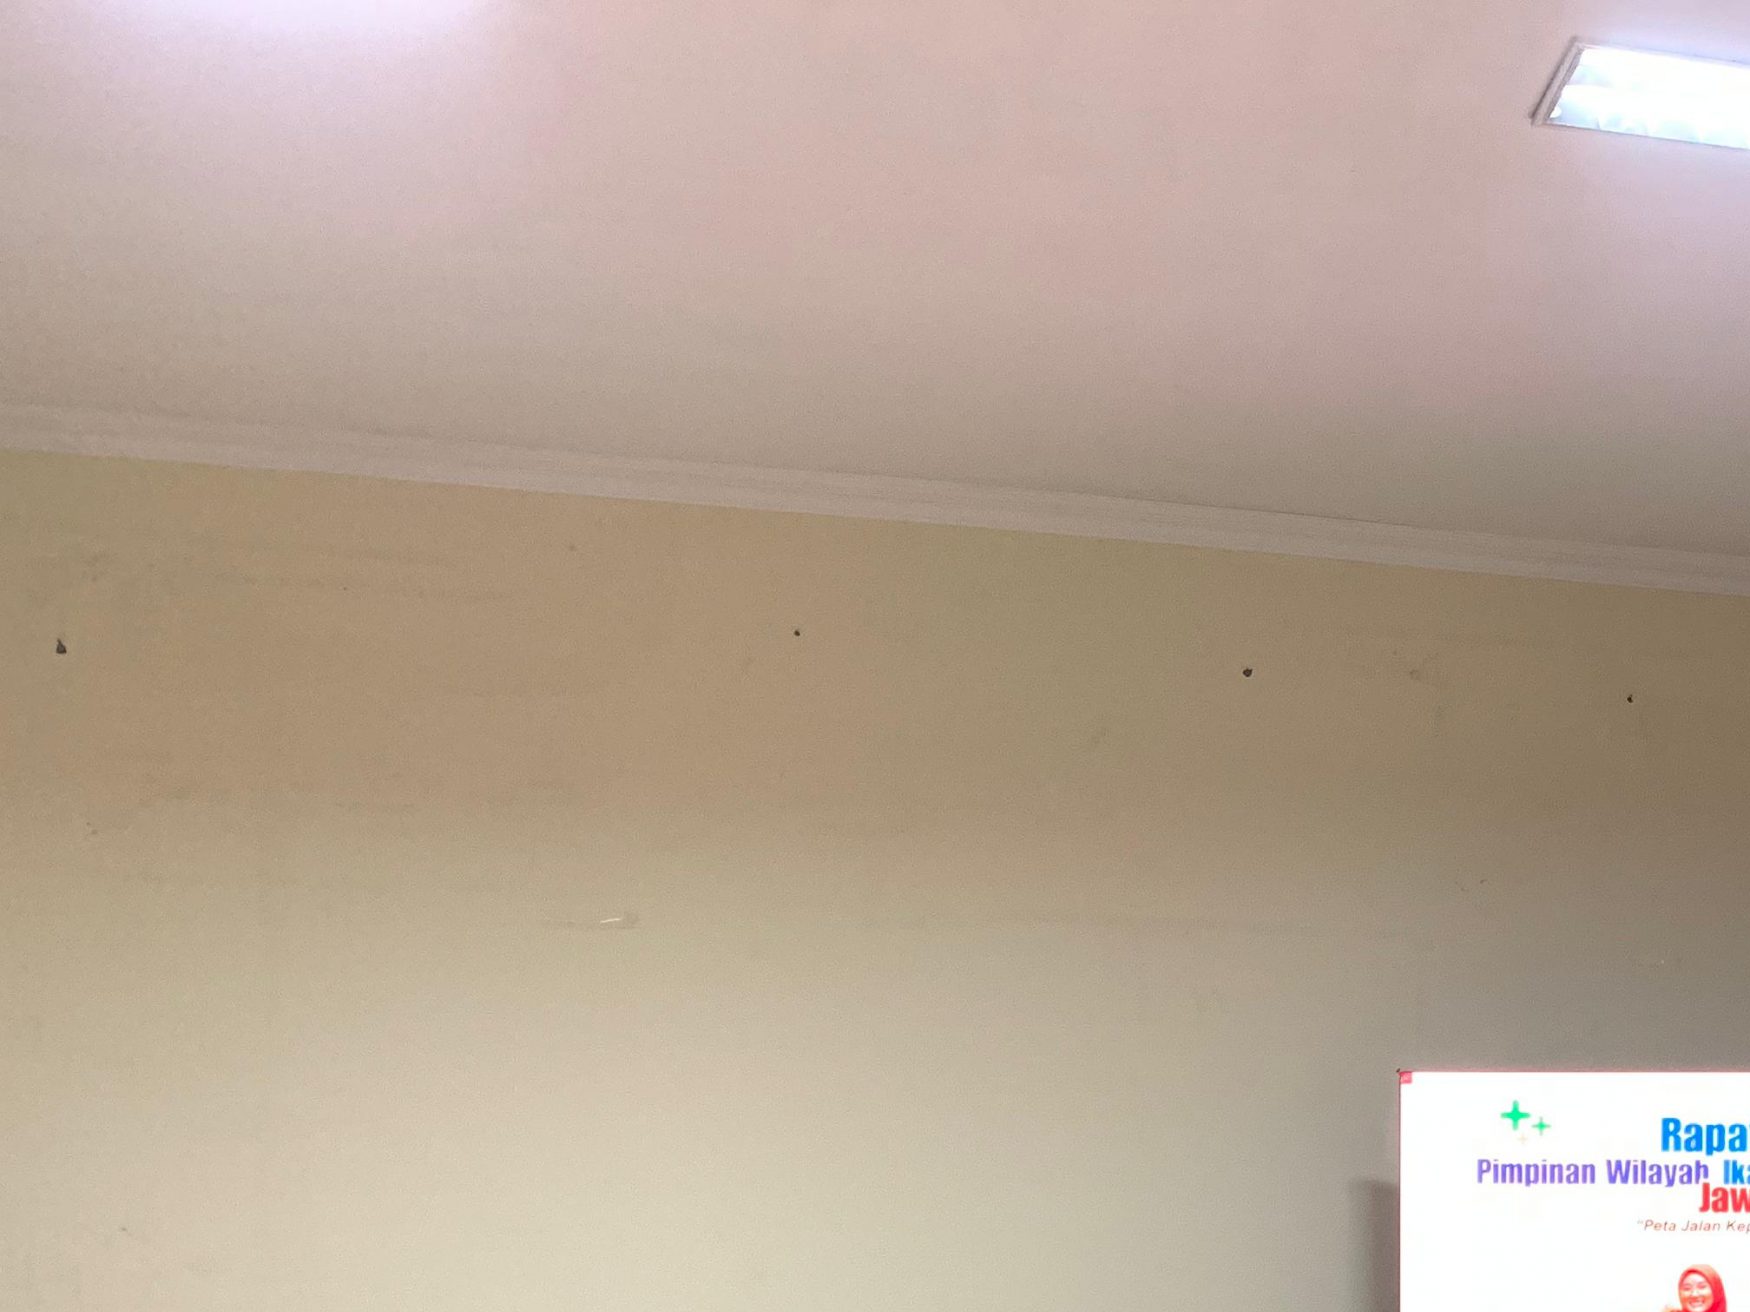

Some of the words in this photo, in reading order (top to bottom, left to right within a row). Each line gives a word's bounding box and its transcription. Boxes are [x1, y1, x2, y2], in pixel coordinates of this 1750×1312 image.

[1477, 1158, 1596, 1187] Pimpinan
[1606, 1159, 1709, 1188] Wilayah
[1681, 1220, 1721, 1232] Jalan
